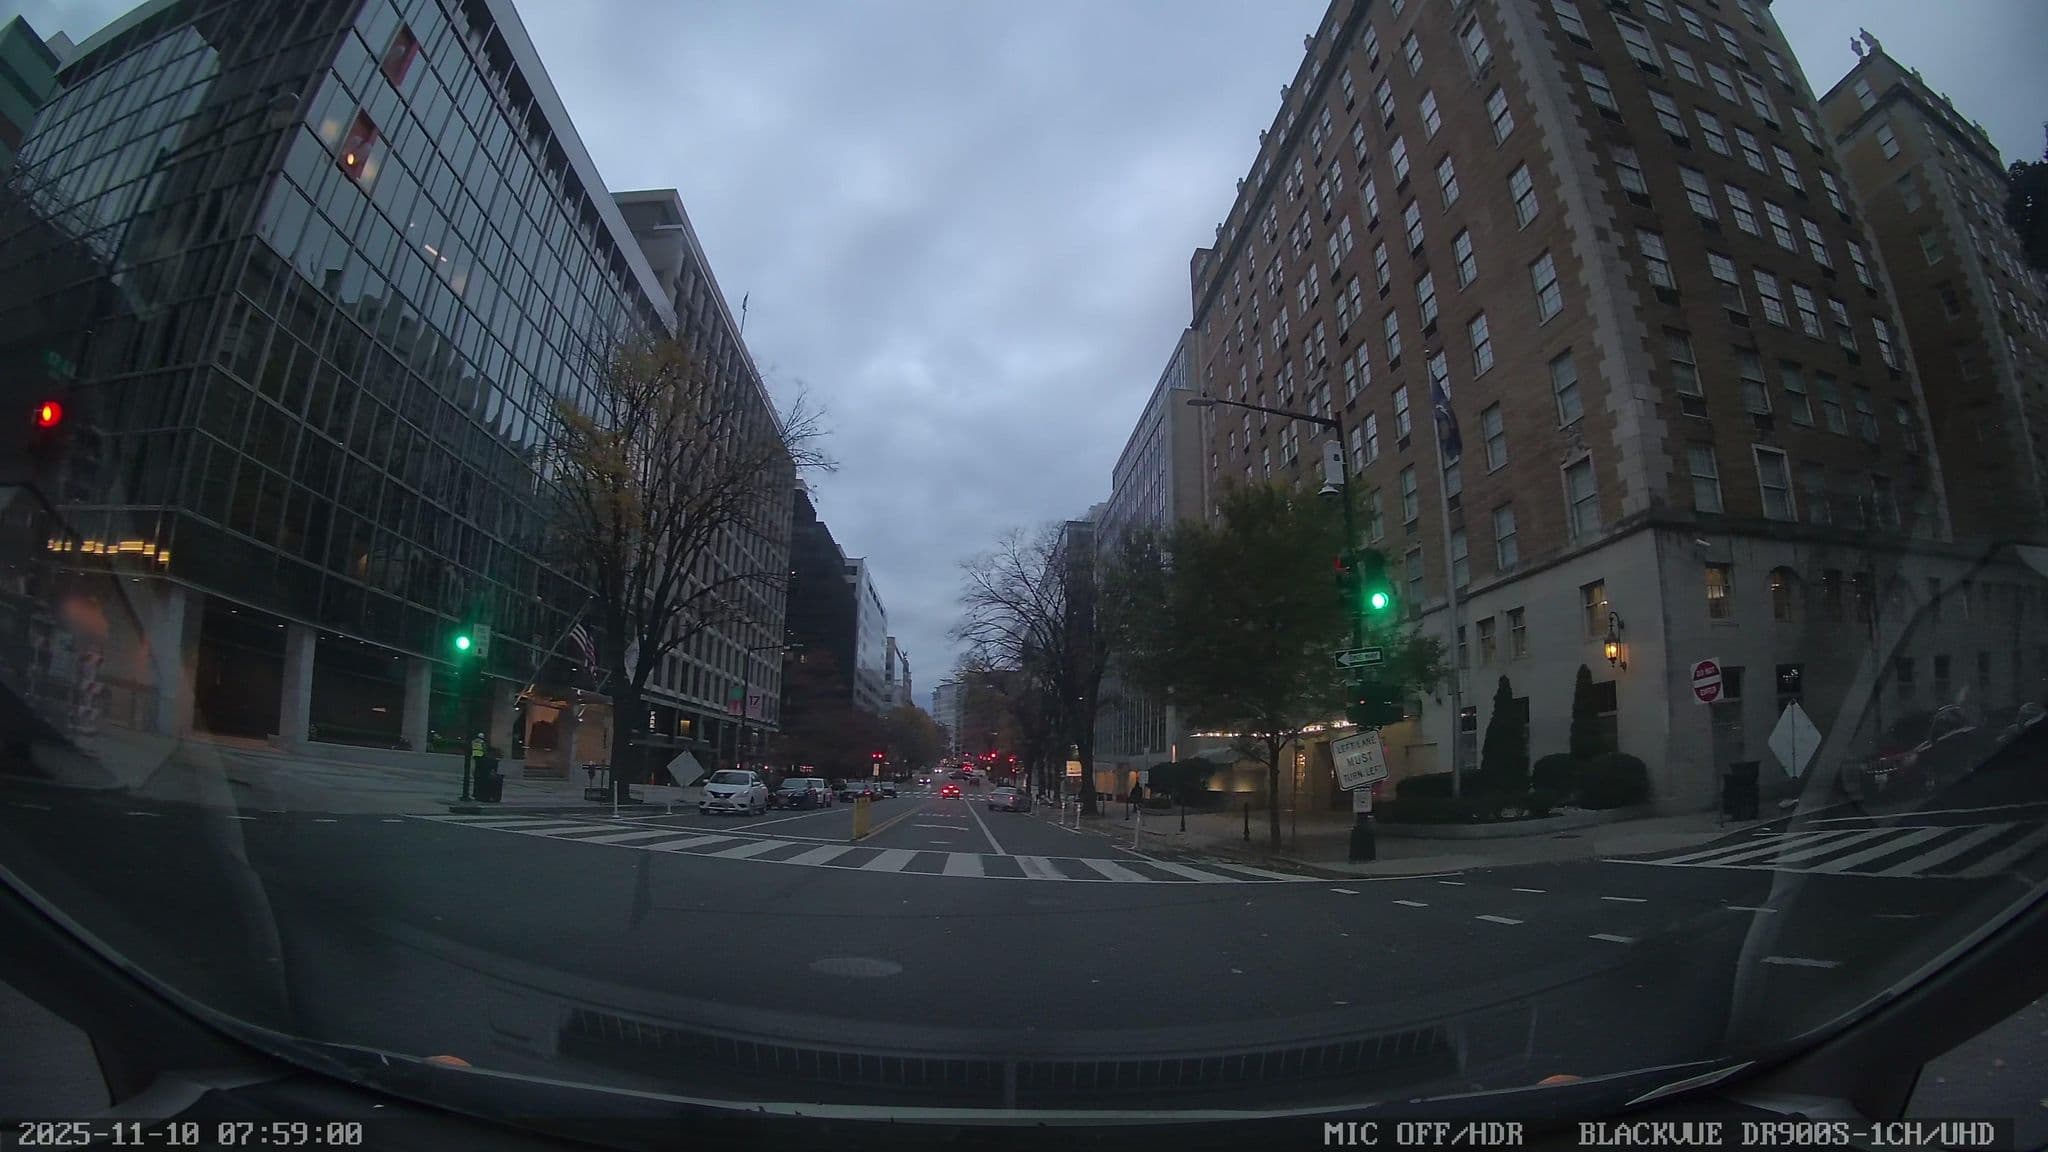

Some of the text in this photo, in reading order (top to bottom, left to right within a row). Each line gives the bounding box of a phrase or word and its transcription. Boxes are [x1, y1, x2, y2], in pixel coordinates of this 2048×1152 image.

[1336, 736, 1377, 754] LEFT LANE
[1346, 751, 1374, 766] MUST
[1344, 770, 1363, 782] TURN
